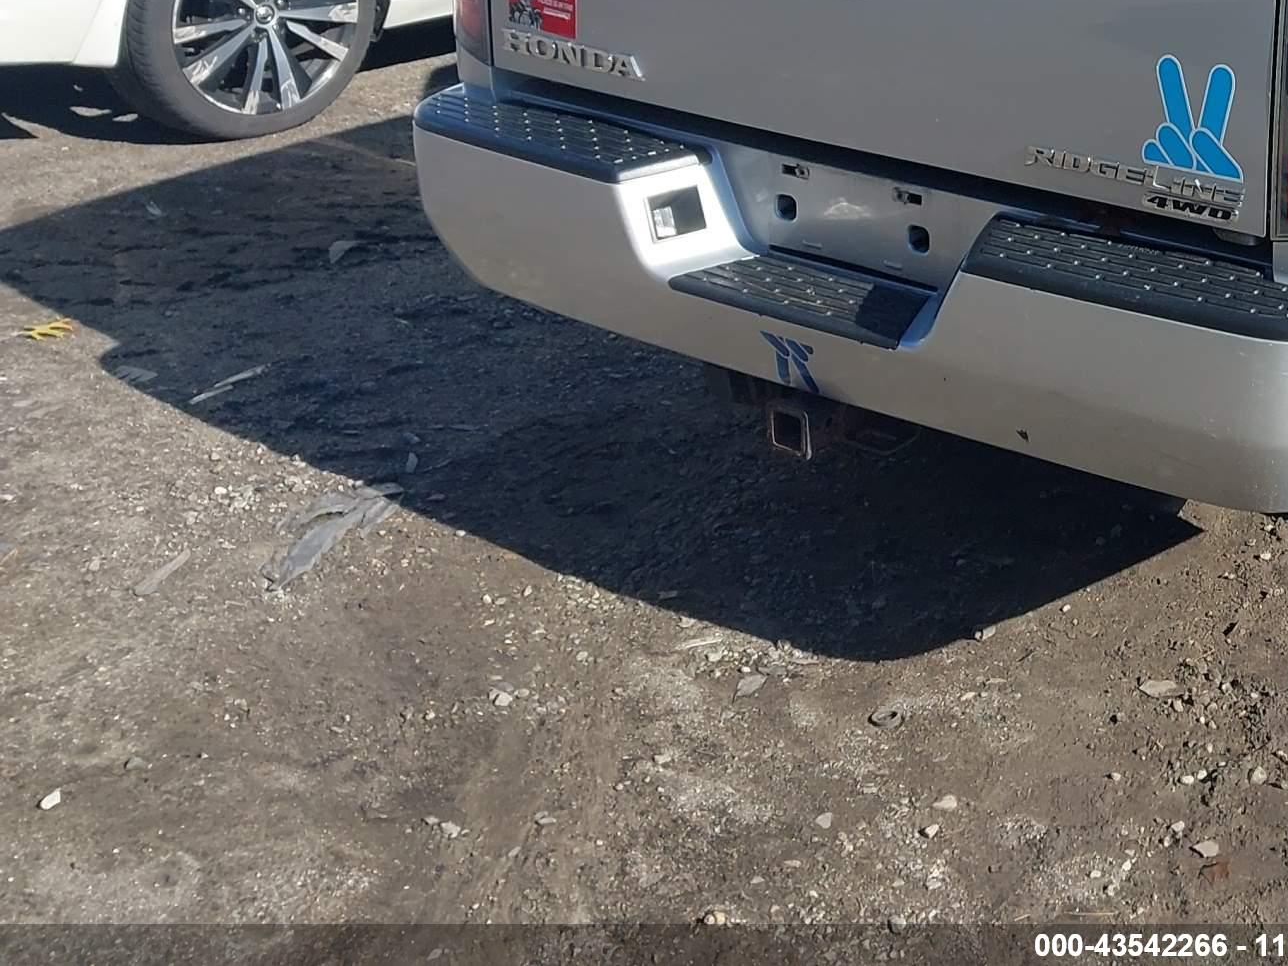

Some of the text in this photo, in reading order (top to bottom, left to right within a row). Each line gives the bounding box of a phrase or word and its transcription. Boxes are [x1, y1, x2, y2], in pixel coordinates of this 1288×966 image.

[502, 28, 646, 81] HONDA
[1024, 145, 1245, 207] RIDGELINE
[1146, 194, 1236, 221] 4WD
